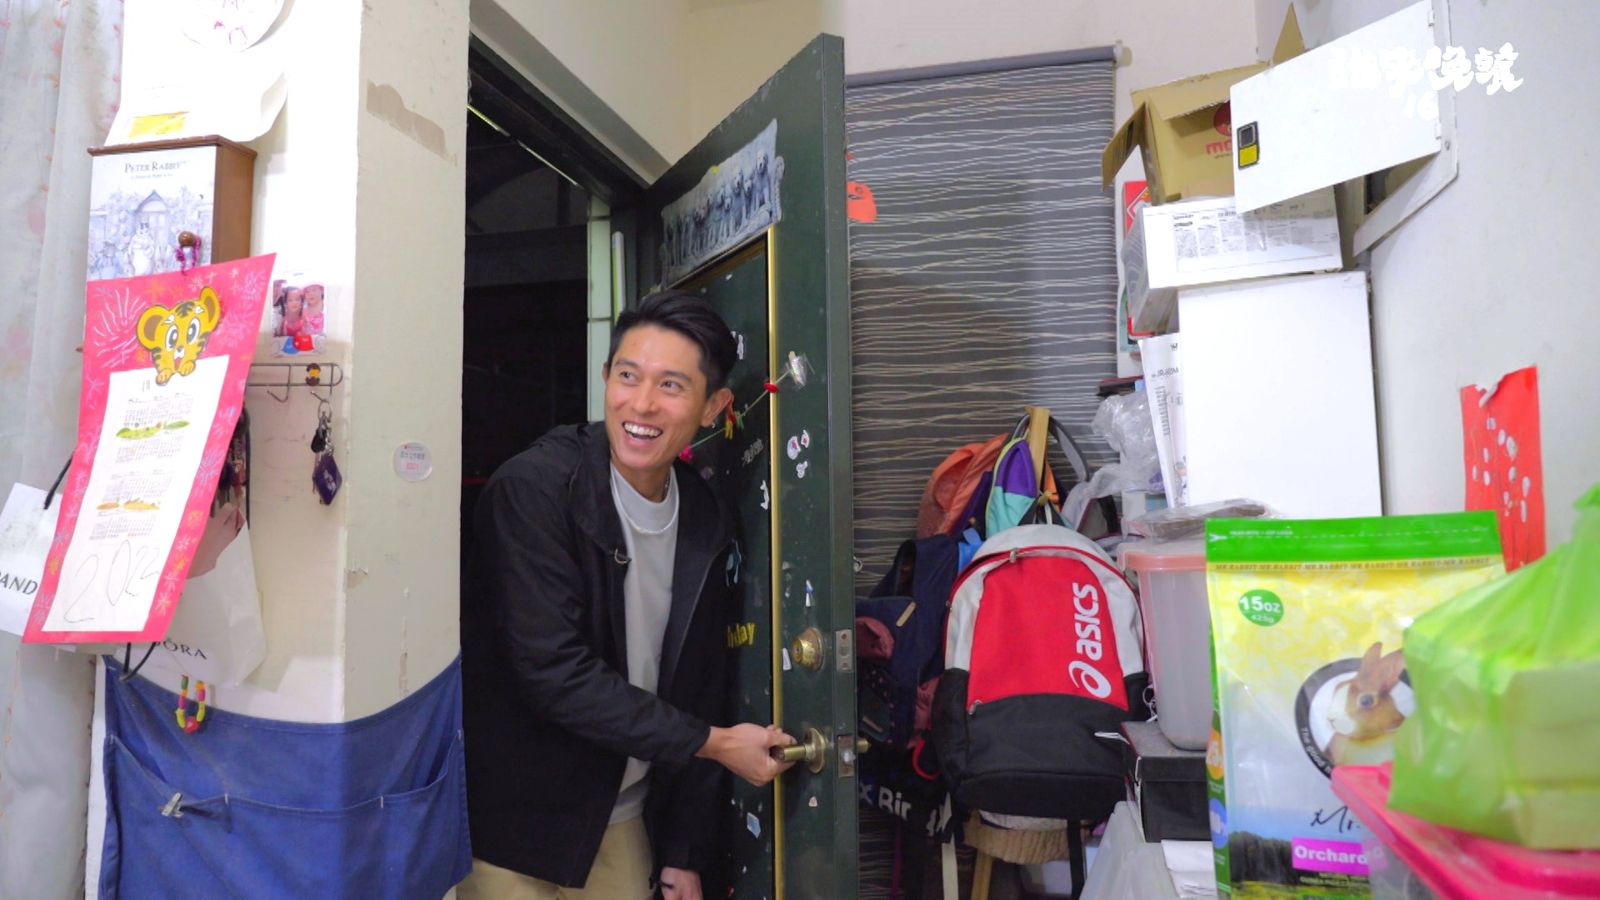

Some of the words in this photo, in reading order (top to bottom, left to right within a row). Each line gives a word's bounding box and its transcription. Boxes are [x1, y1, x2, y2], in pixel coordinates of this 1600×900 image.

[0, 571, 38, 595] AND
[1072, 582, 1102, 660] asics
[155, 638, 207, 659] ORA
